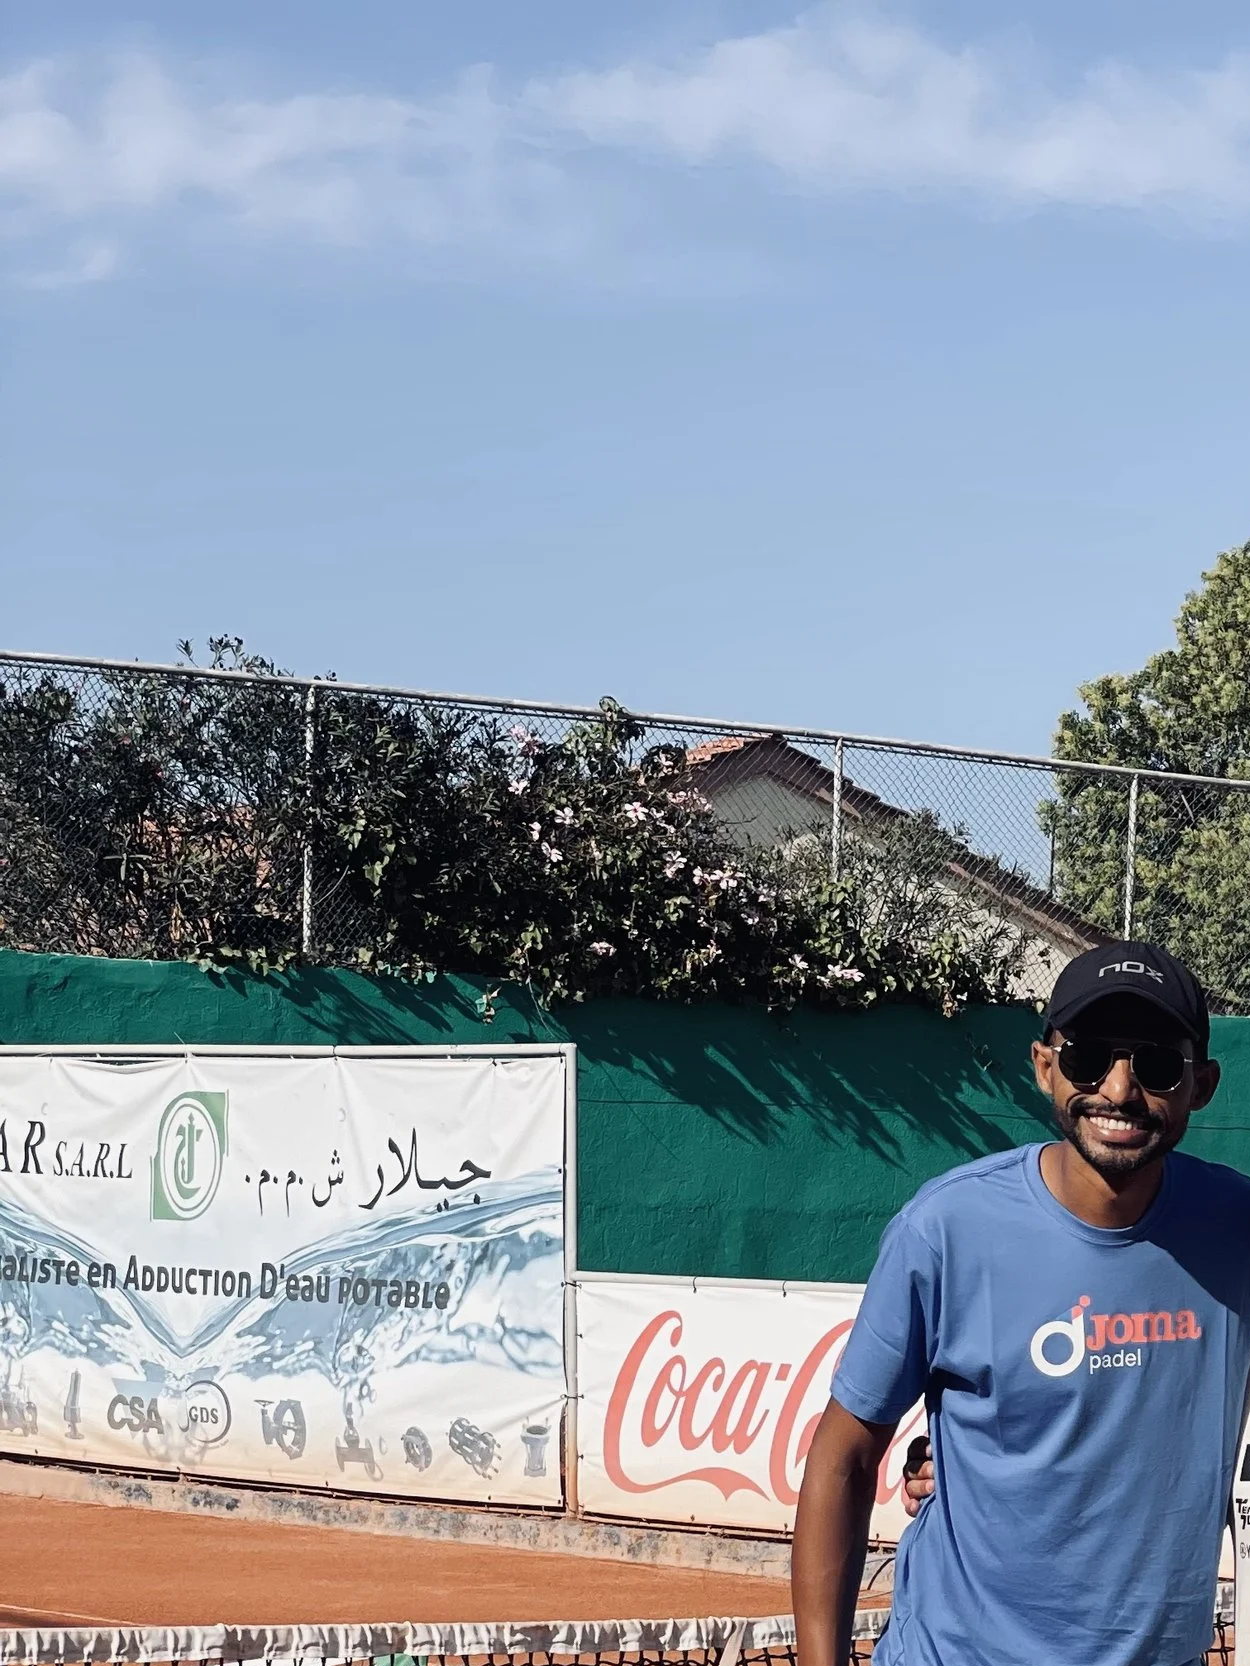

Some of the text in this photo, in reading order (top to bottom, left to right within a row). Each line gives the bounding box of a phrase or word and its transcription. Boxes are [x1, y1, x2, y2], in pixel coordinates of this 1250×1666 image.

[358, 1126, 492, 1212] جيلار
[87, 1261, 117, 1289] en
[1090, 1348, 1142, 1375] padel
[107, 1394, 165, 1435] CSA
[189, 1406, 219, 1425] GDS
